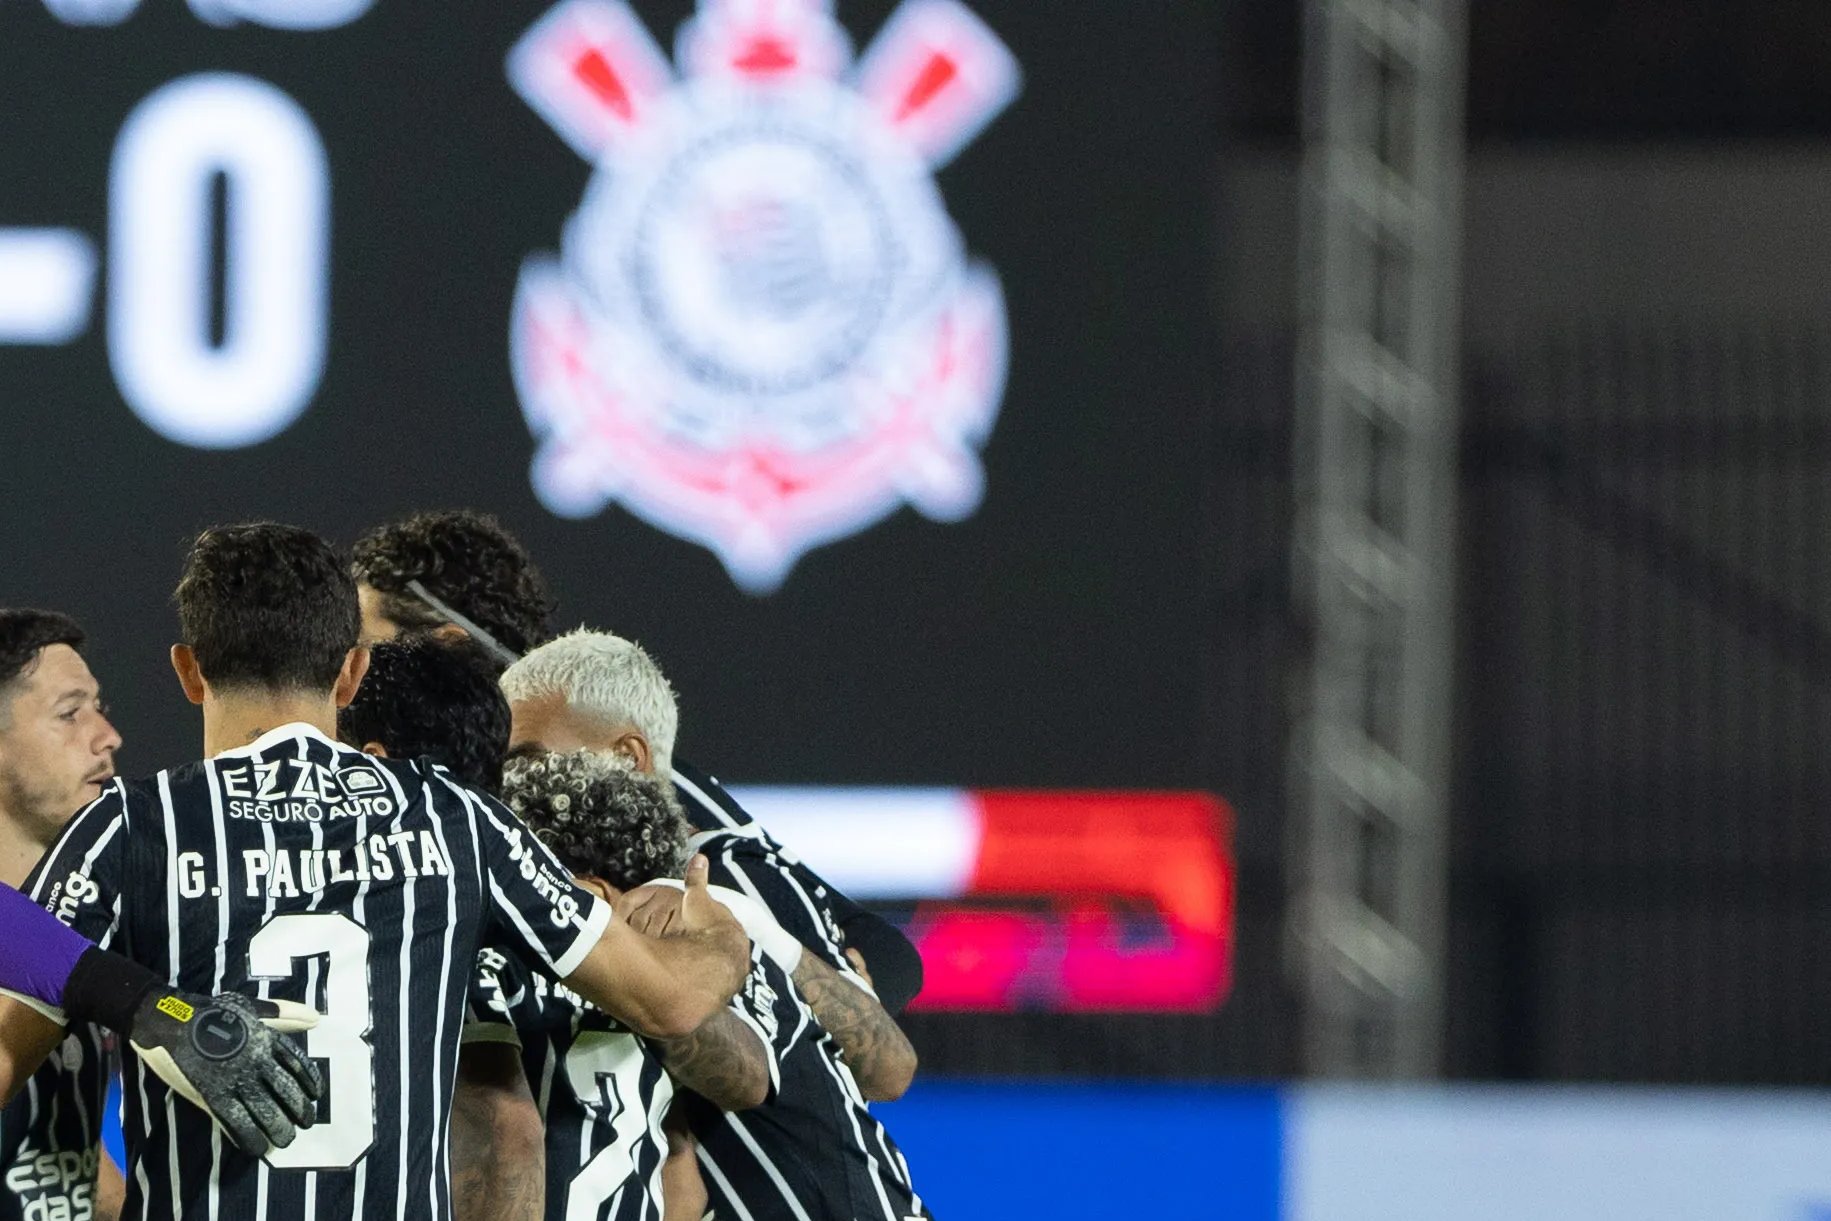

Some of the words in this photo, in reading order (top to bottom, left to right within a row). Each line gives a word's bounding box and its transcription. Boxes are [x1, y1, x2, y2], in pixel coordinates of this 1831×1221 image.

[222, 758, 346, 804] EZZE
[229, 800, 324, 824] SEGURO
[328, 796, 394, 821] AUTO
[177, 851, 224, 899] G.
[242, 830, 449, 898] PAULISTA
[539, 863, 573, 892] banco
[45, 881, 62, 912] anco
[55, 870, 100, 928] mg
[248, 911, 377, 1170] 3
